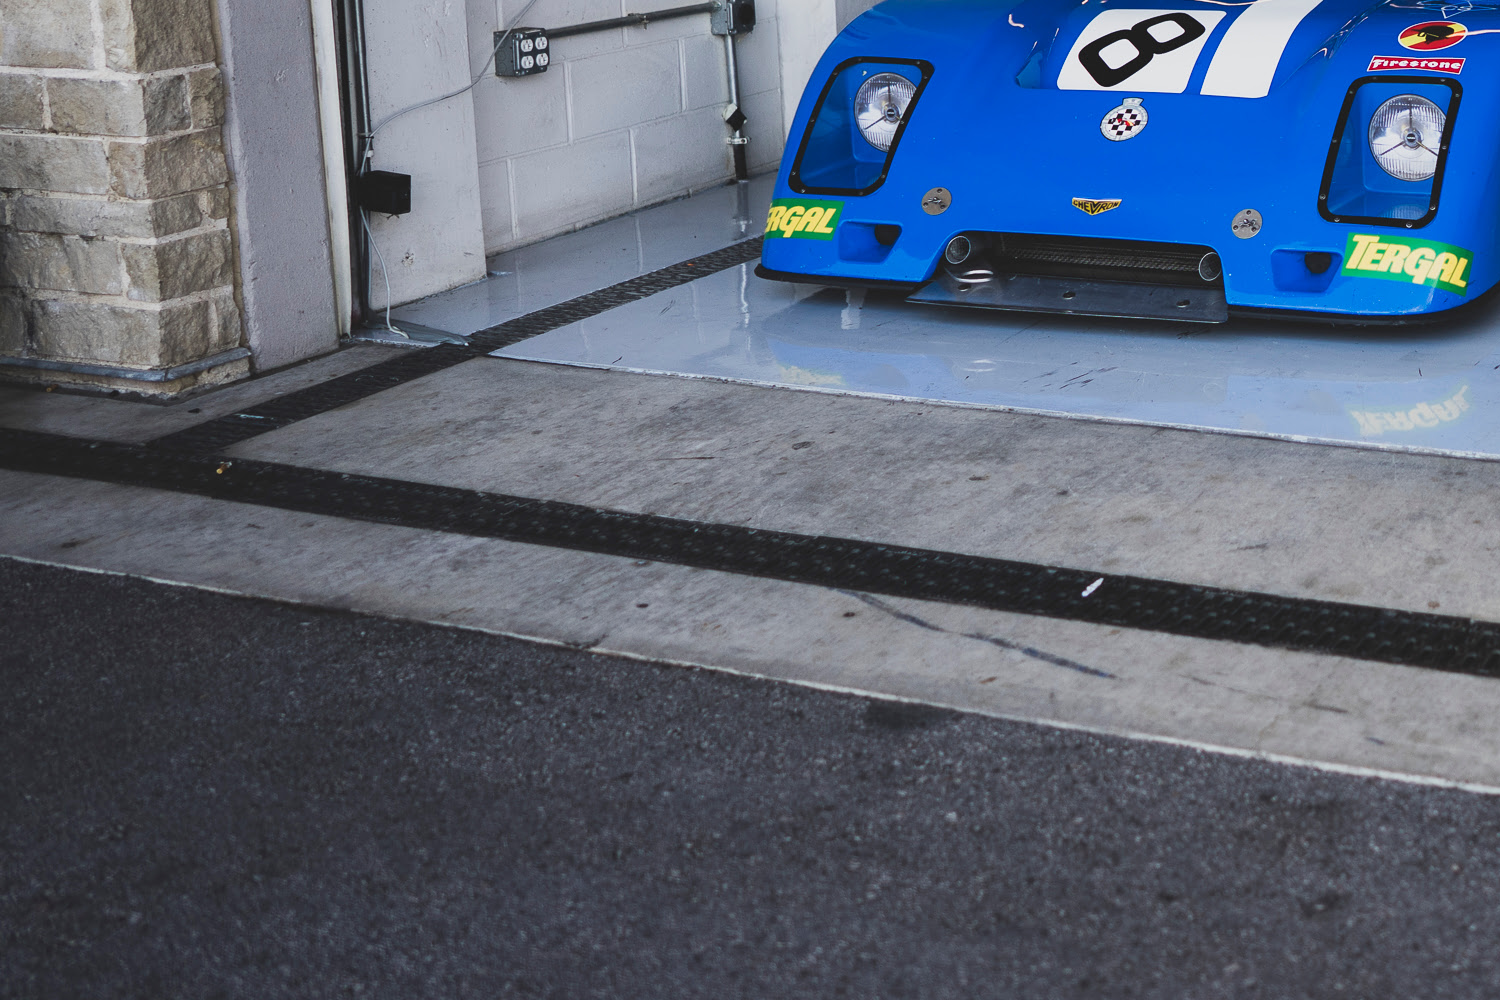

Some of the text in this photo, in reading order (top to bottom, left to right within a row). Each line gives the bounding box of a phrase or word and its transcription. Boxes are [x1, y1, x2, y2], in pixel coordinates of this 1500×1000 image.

[1078, 12, 1206, 88] 8
[1372, 58, 1462, 70] Firestone
[764, 203, 837, 238] ERGAL
[1072, 199, 1120, 215] CHEVRON
[1345, 234, 1469, 288] TERGAL
